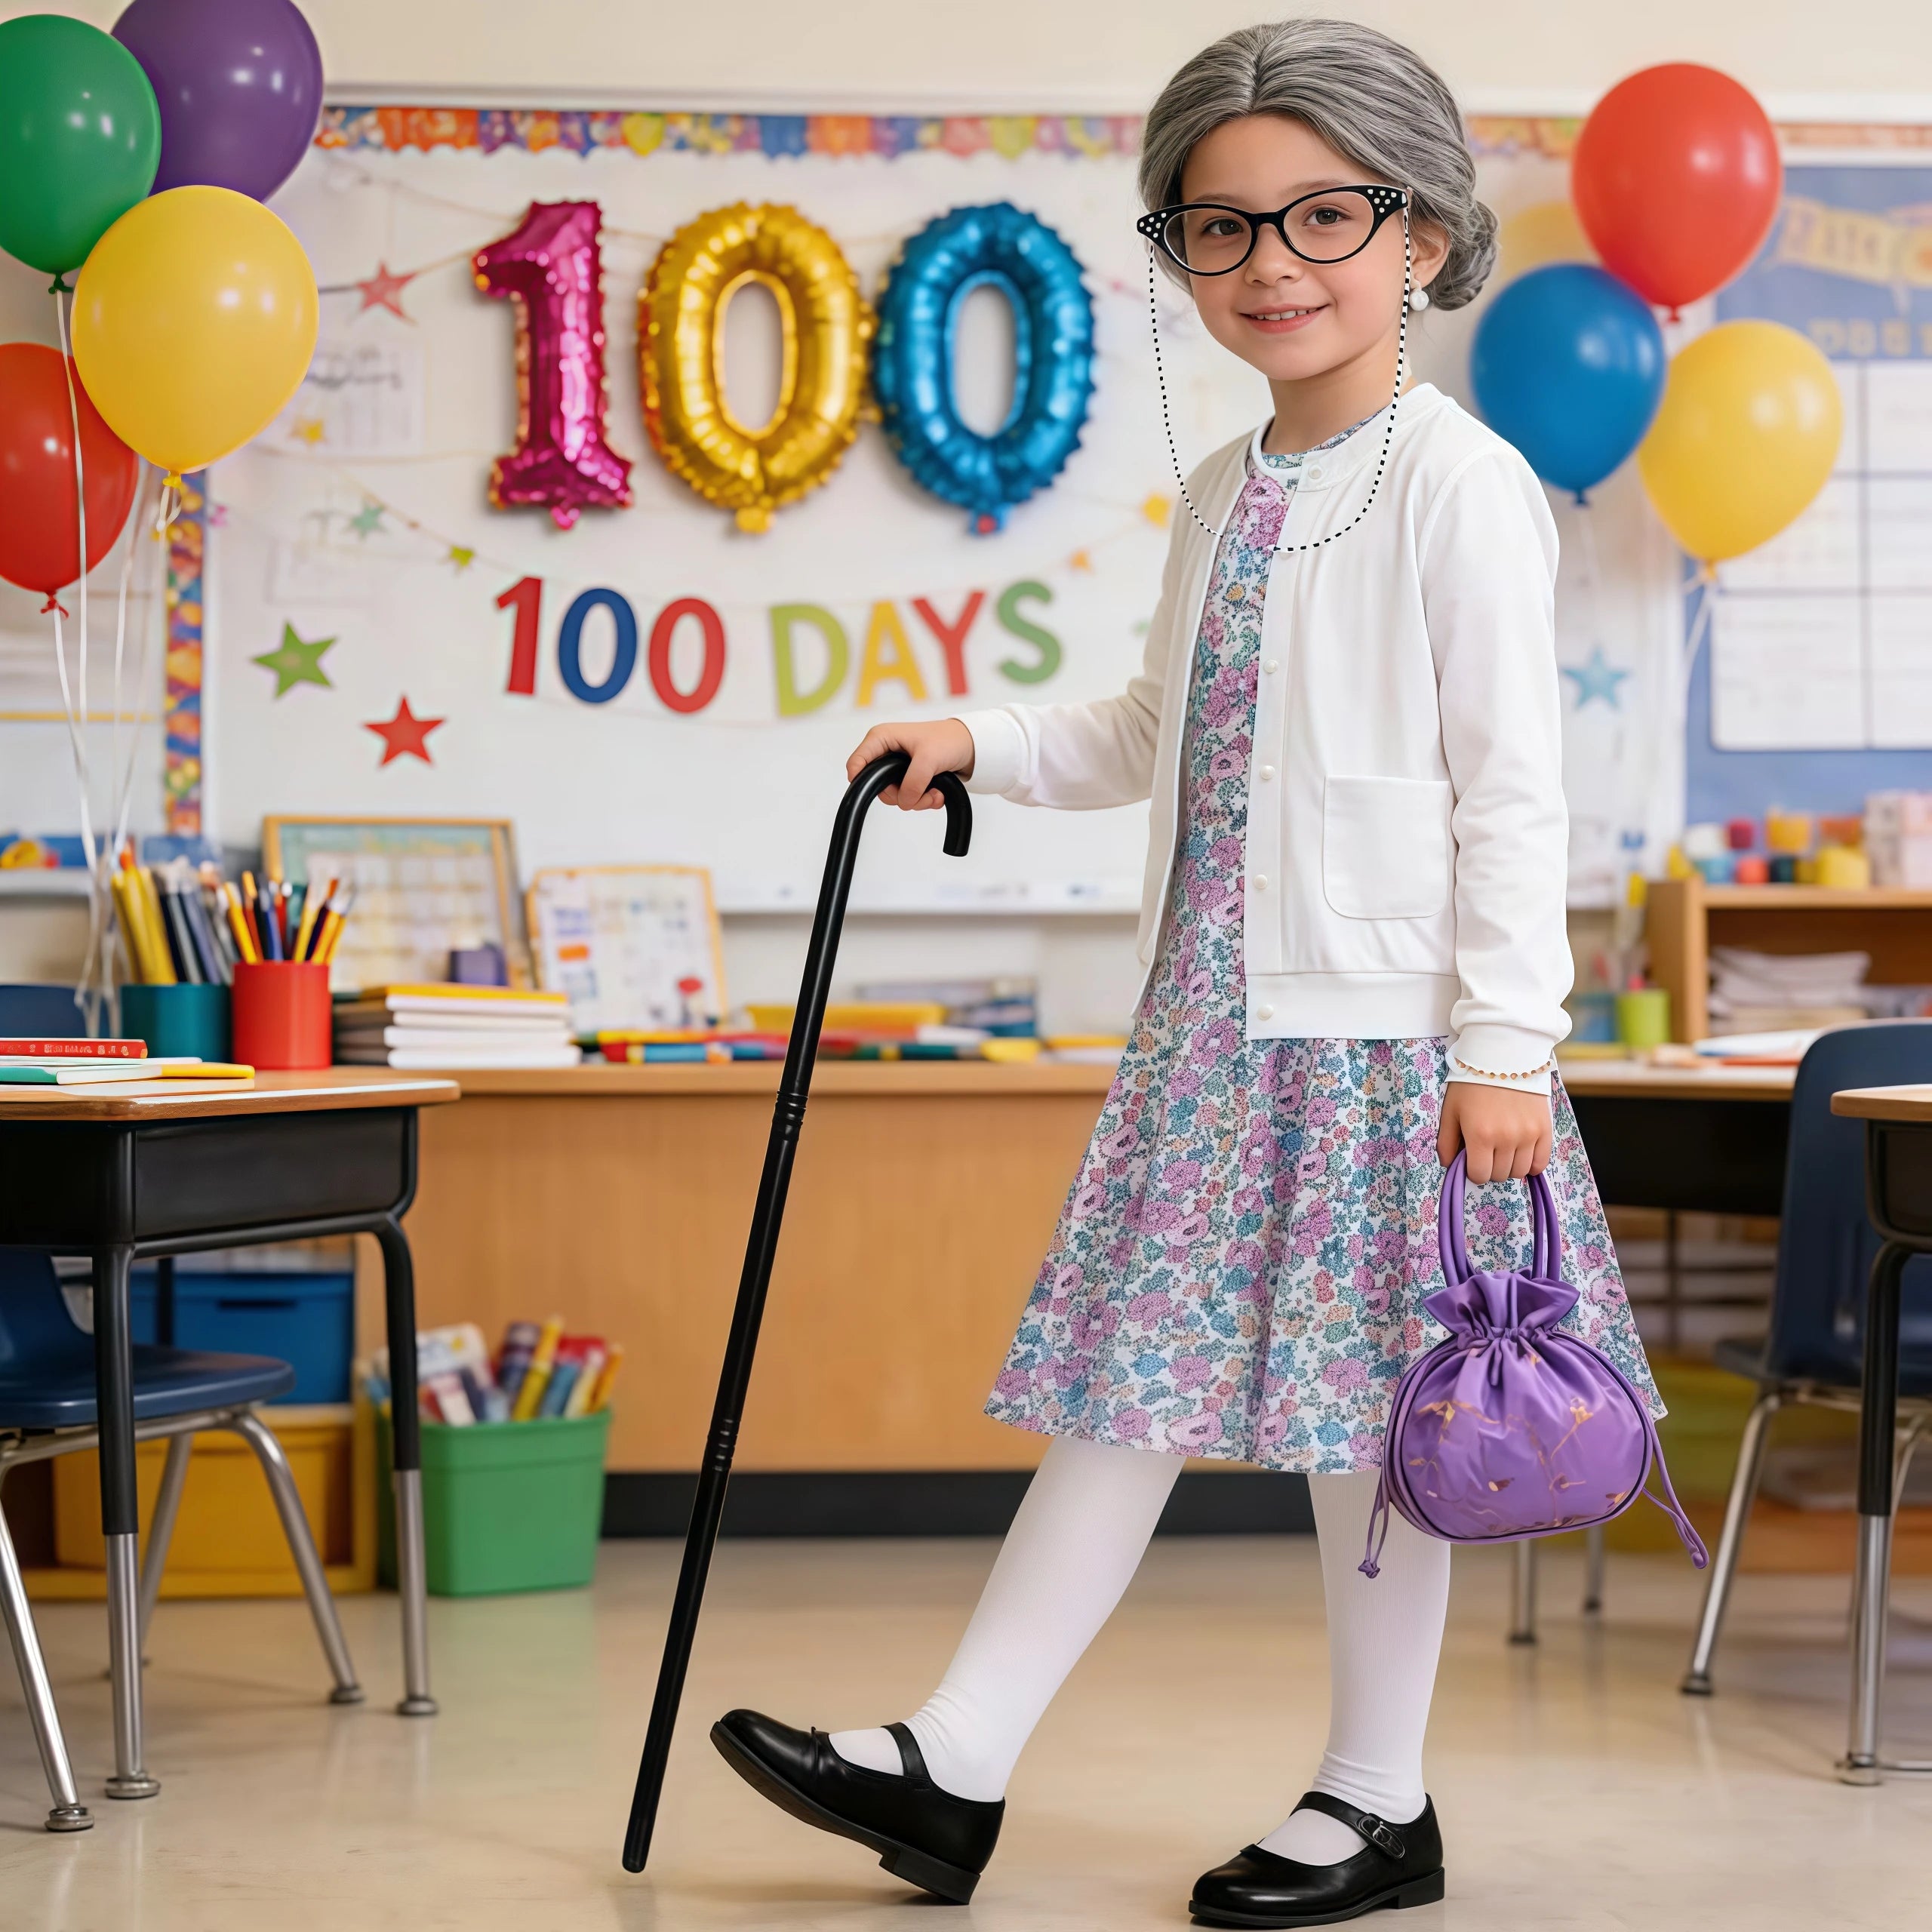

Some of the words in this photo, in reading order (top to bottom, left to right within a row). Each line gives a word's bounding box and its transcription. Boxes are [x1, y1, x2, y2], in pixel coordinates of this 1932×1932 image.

[472, 200, 1097, 533] 100
[495, 577, 725, 714] 100
[769, 580, 1063, 717] DAYS
